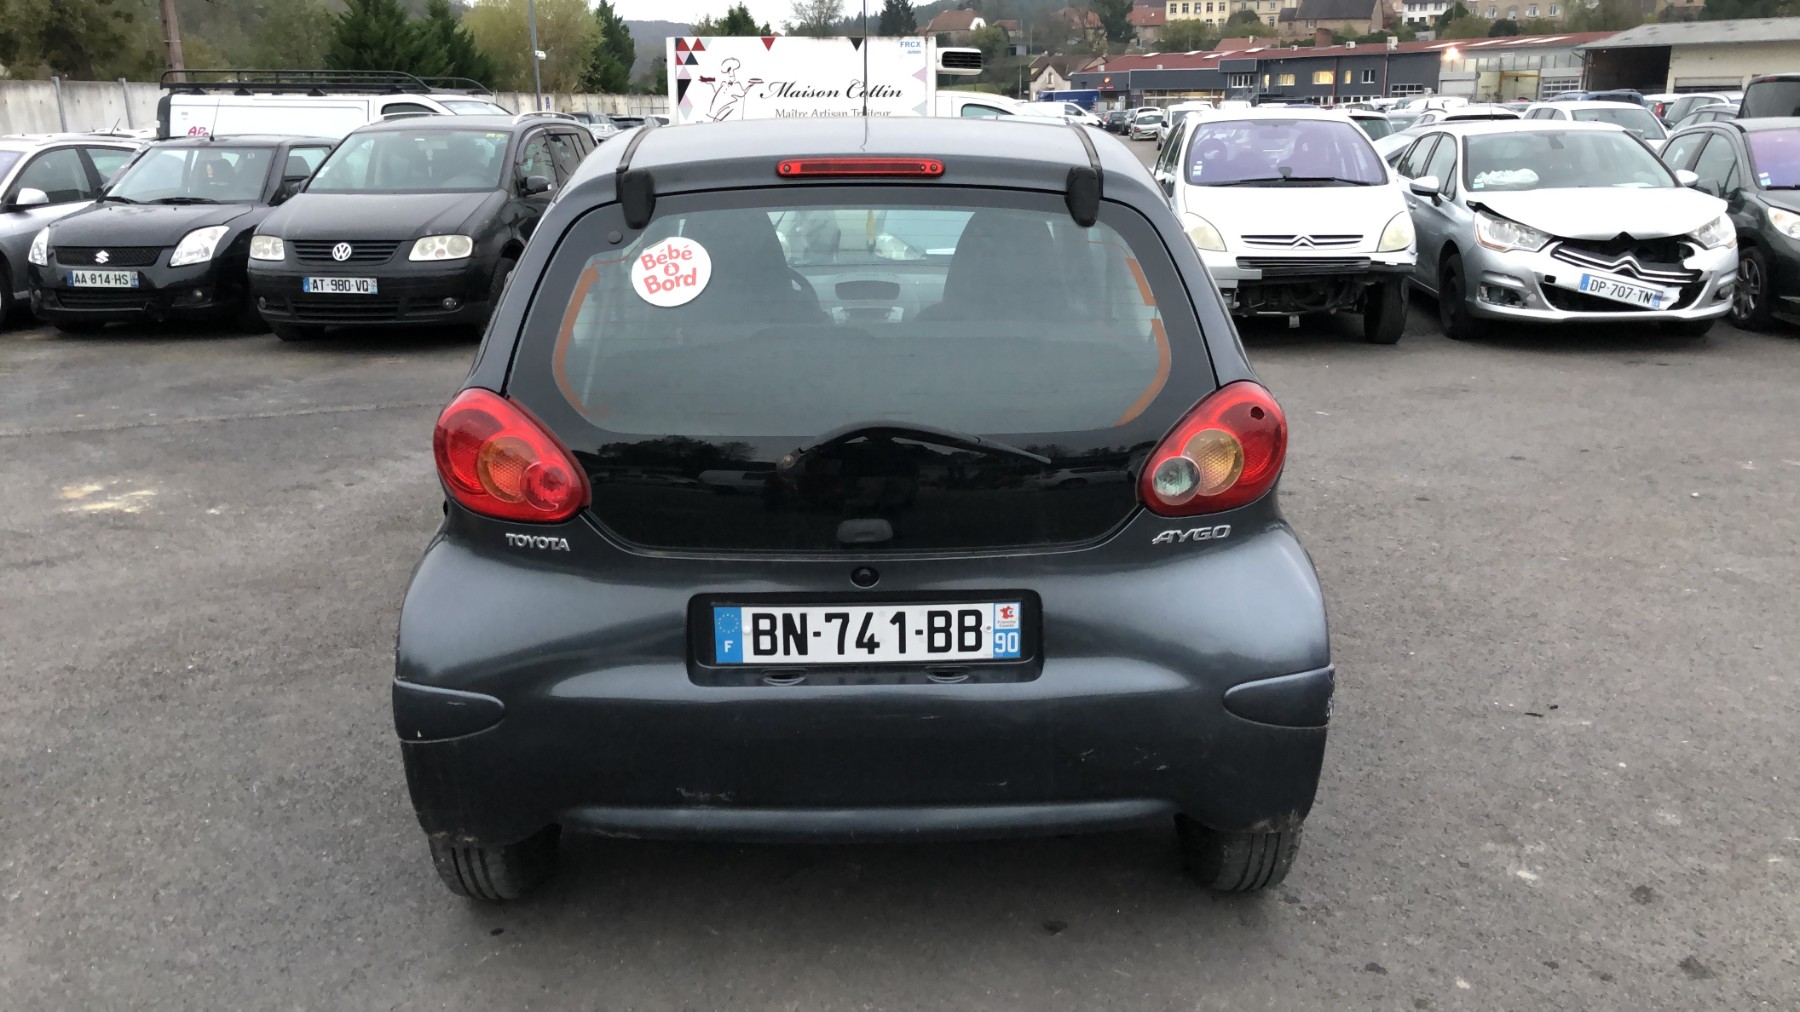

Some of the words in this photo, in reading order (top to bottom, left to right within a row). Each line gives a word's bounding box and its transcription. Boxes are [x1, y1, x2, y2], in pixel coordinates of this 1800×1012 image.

[759, 80, 840, 99] Maison
[811, 108, 848, 118] Artisan
[851, 108, 892, 117] Triteur
[641, 244, 693, 271] Bébé
[643, 267, 697, 295] Bord
[505, 533, 570, 552] TOYOTA
[1152, 525, 1231, 545] AYGO
[752, 609, 983, 656] BN-741-BB
[995, 632, 1019, 653] 90
[724, 640, 734, 653] F
